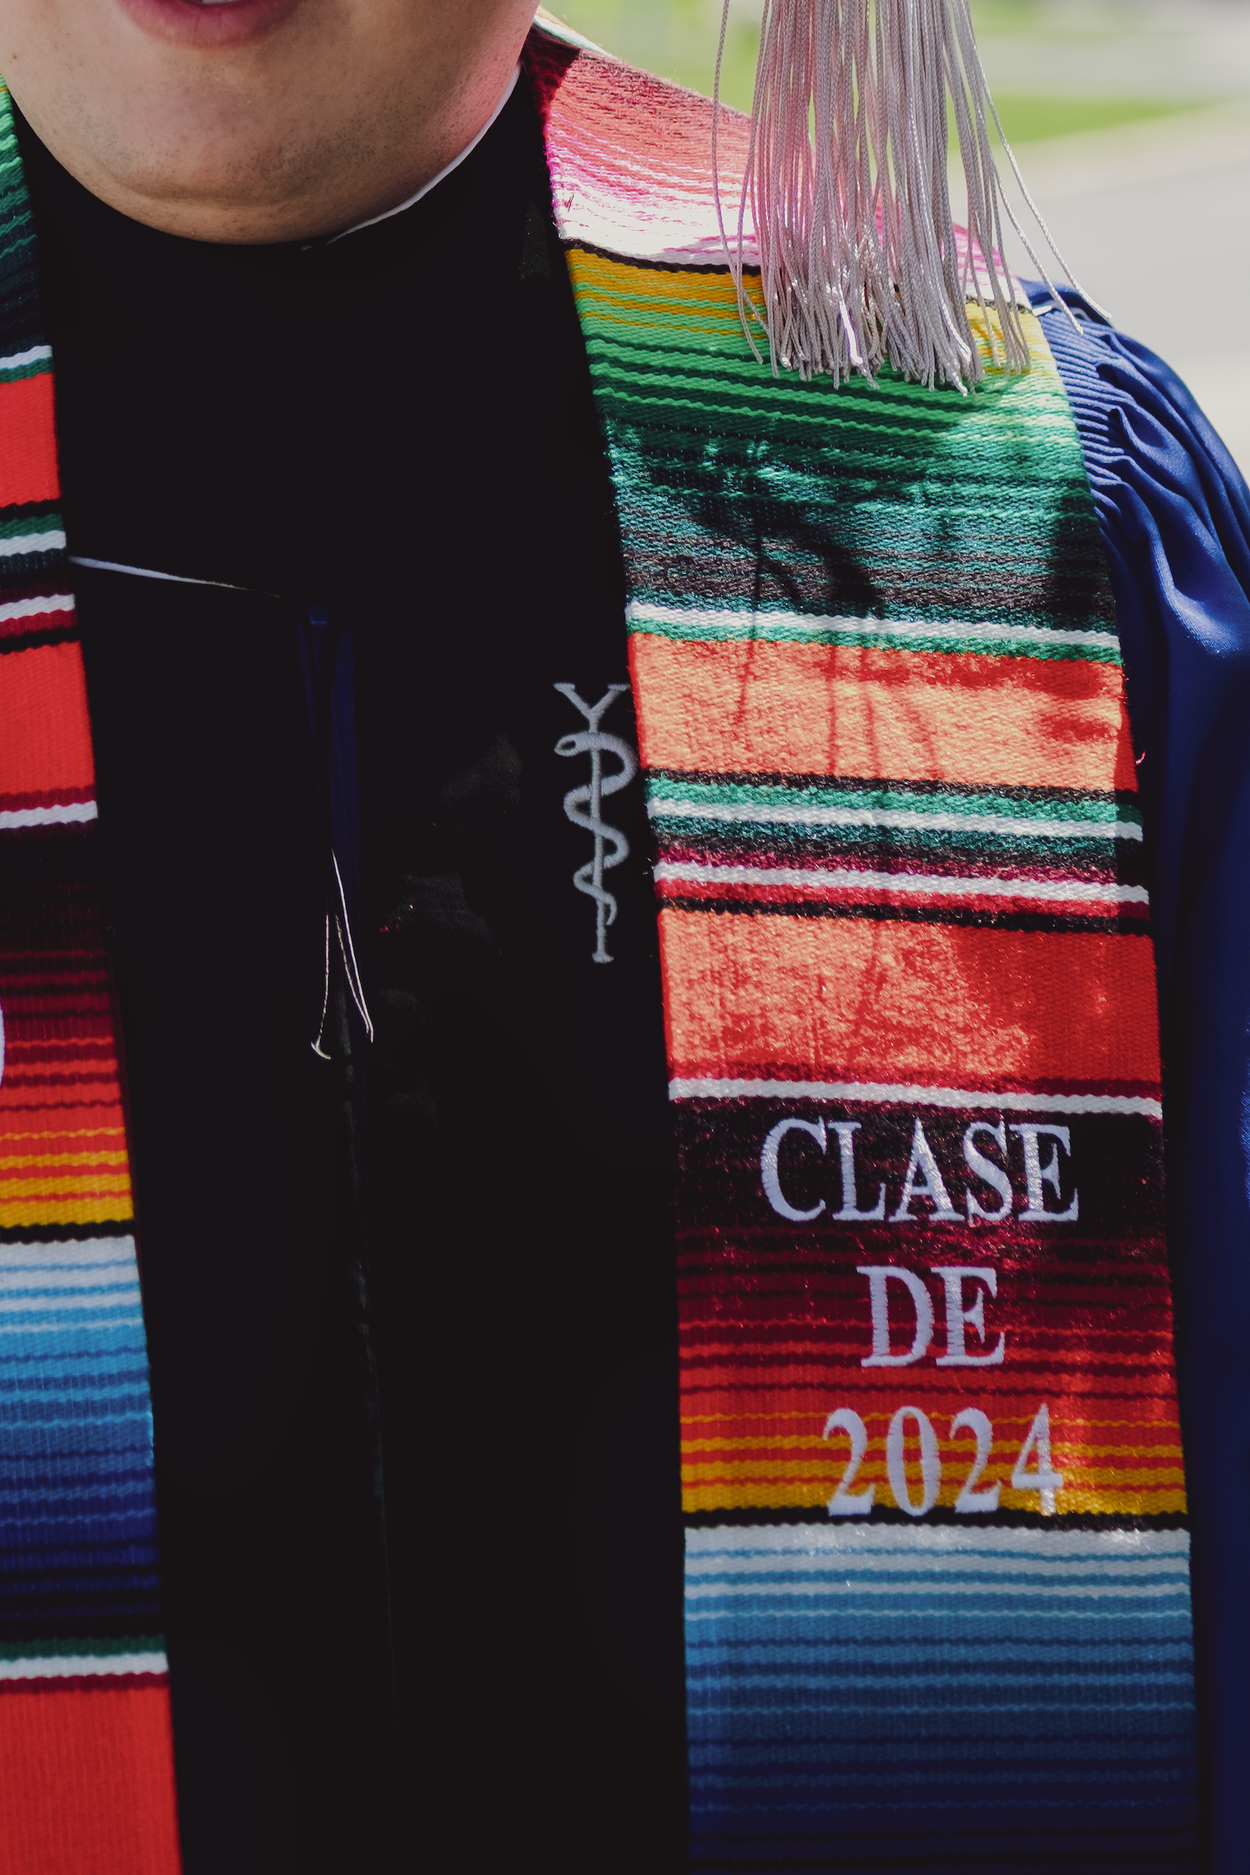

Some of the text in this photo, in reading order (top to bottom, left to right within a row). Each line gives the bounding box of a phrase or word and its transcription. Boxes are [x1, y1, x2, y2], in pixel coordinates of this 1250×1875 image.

[760, 1115, 1080, 1227] CLASE
[855, 1265, 1006, 1368] DE
[822, 1402, 1065, 1517] 2024
